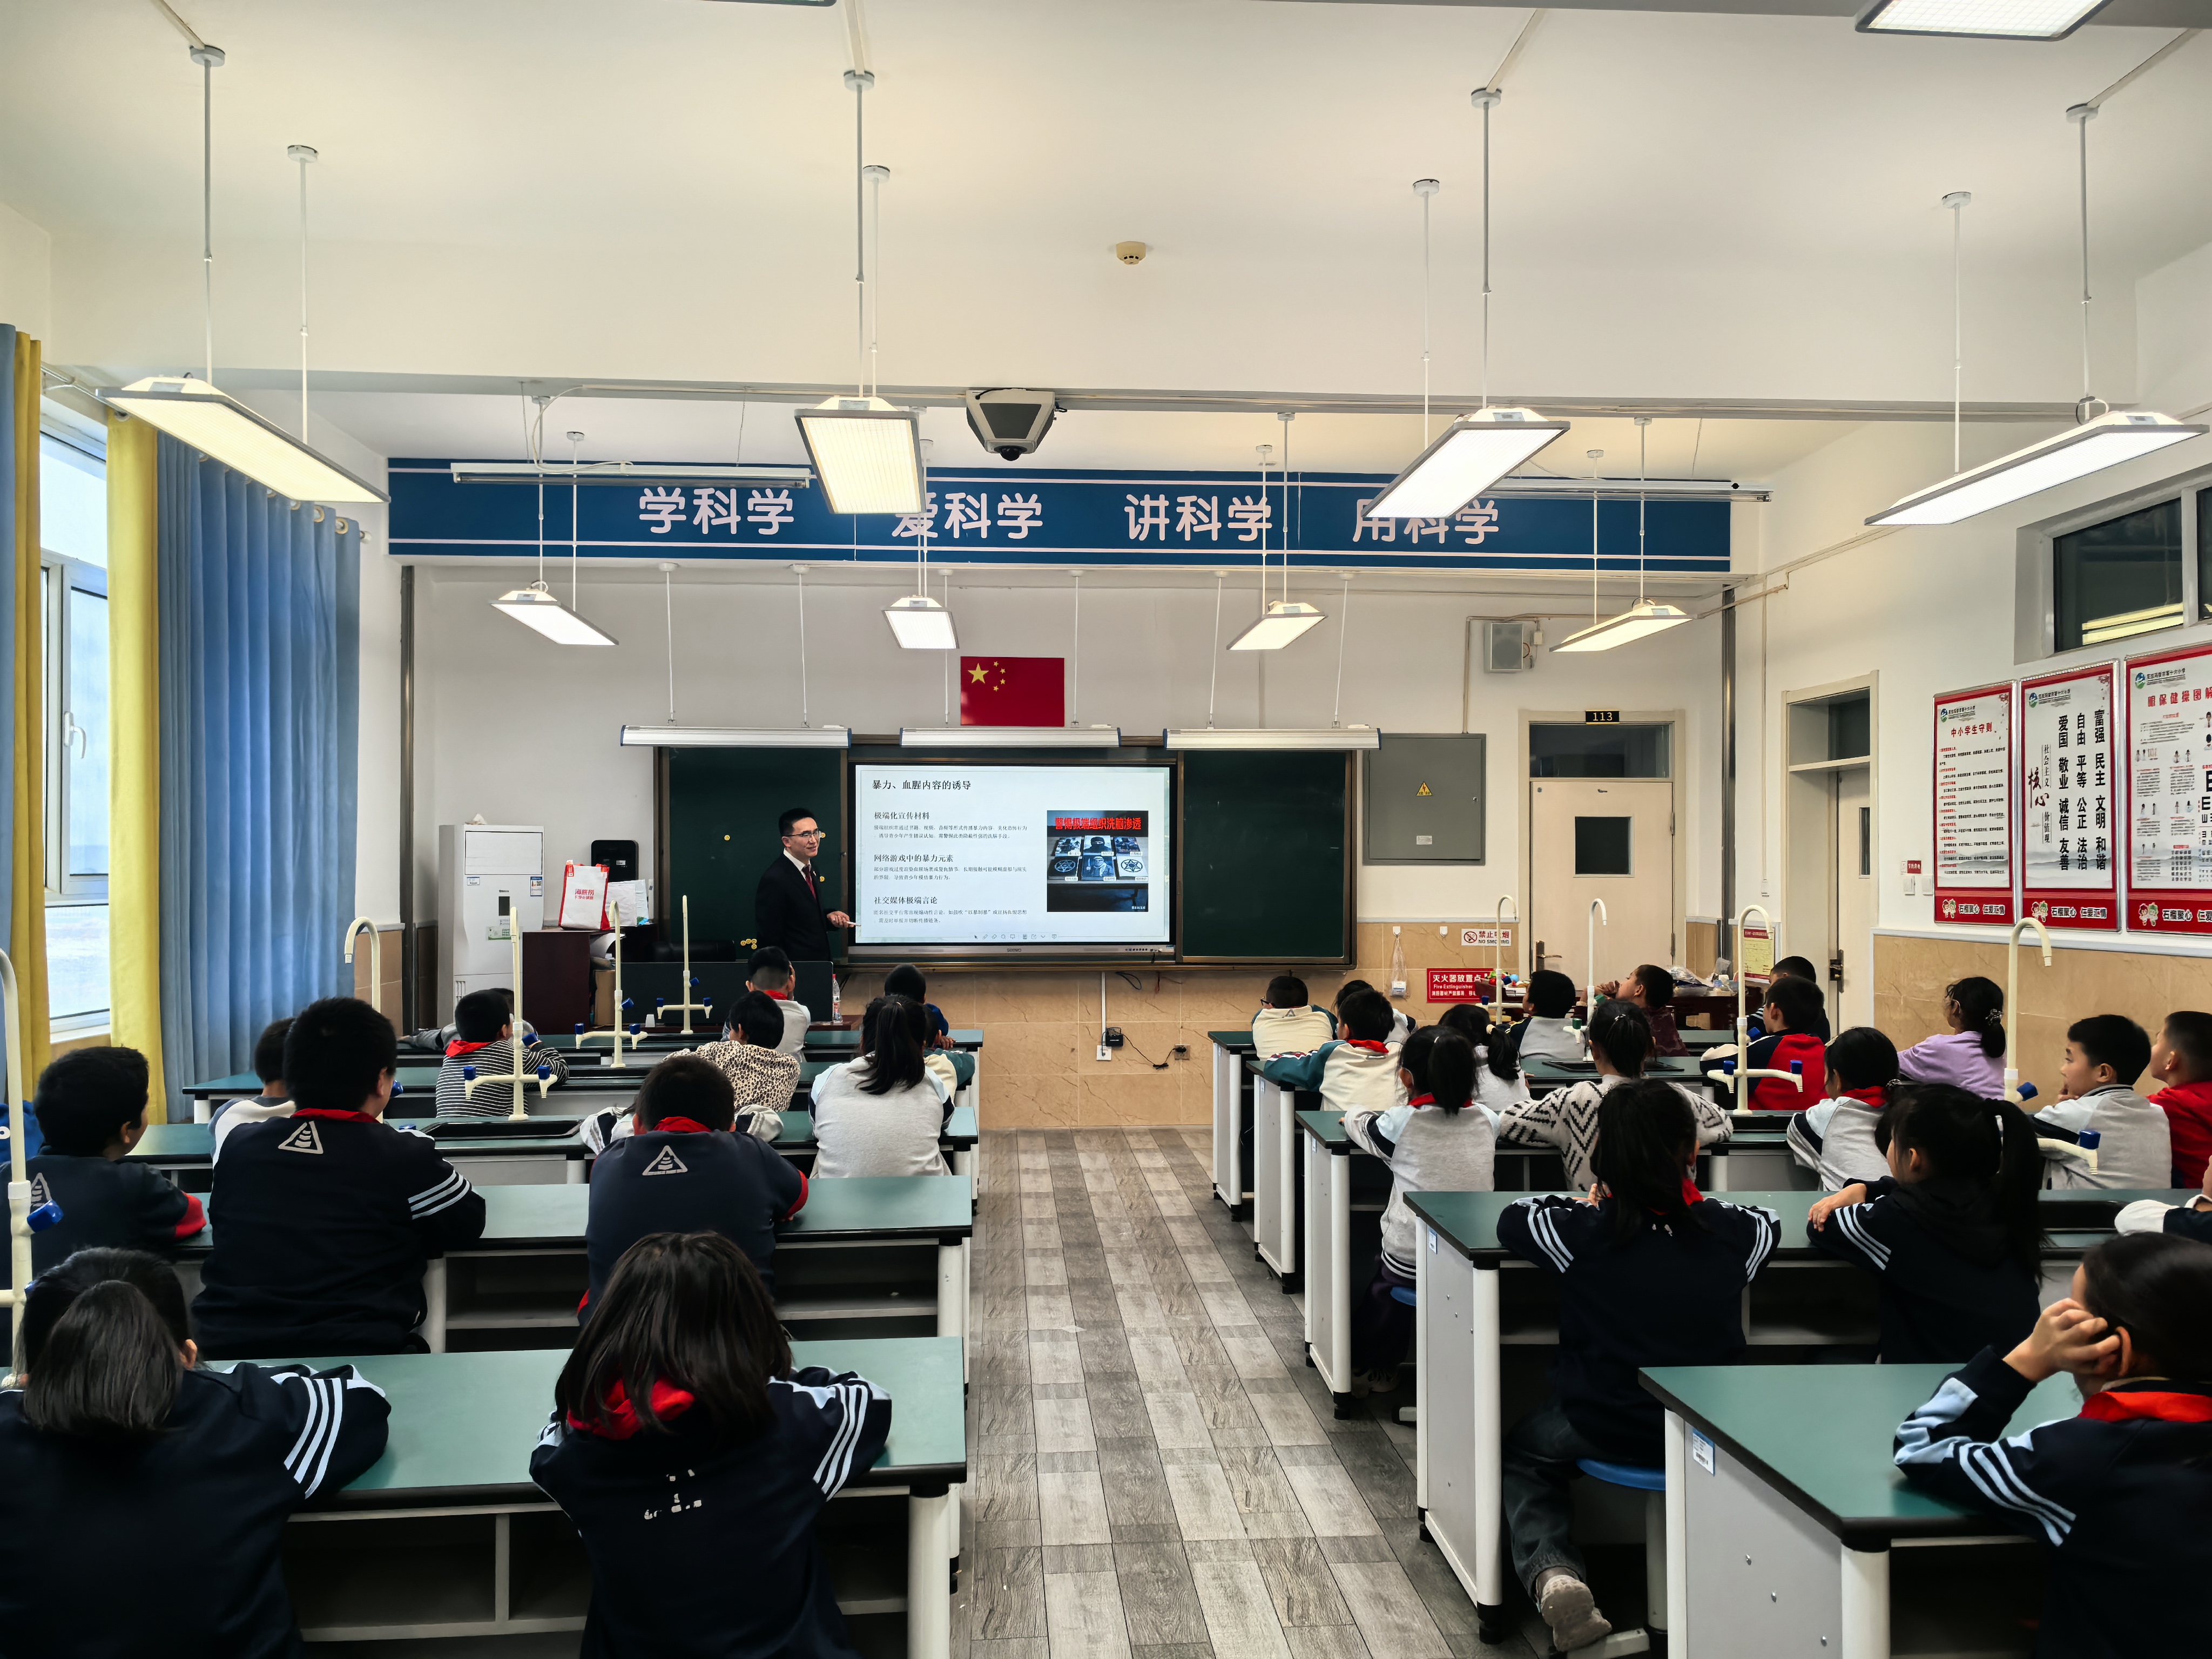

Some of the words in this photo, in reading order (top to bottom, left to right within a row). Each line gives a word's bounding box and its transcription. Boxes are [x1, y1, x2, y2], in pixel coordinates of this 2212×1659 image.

[639, 487, 794, 535] 学科学
[892, 492, 1043, 539] 爱科学
[1124, 494, 1272, 542] 讲科学
[1352, 498, 1499, 545] 用科学
[1593, 712, 1613, 721] 113
[1951, 722, 1992, 738] 中小学生守则
[2059, 715, 2068, 748] 爱国
[2077, 713, 2086, 746] 自由
[2095, 710, 2105, 744] 富强
[872, 780, 971, 790] 暴力、血腥内容的诱导
[2059, 757, 2069, 790] 敬业
[2076, 755, 2087, 788] 平等
[2095, 753, 2106, 786] 民主
[2028, 767, 2049, 808] 核心
[874, 812, 930, 820] 极端化宣传材料
[2059, 798, 2069, 831] 诚信
[2077, 797, 2087, 829] 公正
[2095, 795, 2106, 829] 文明
[874, 854, 953, 862] 网络游戏中的暴力元素
[2059, 838, 2069, 871] 友善
[2078, 838, 2087, 870] 法治
[2096, 837, 2106, 871] 和谐
[874, 896, 938, 905] 社交媒体极端言论
